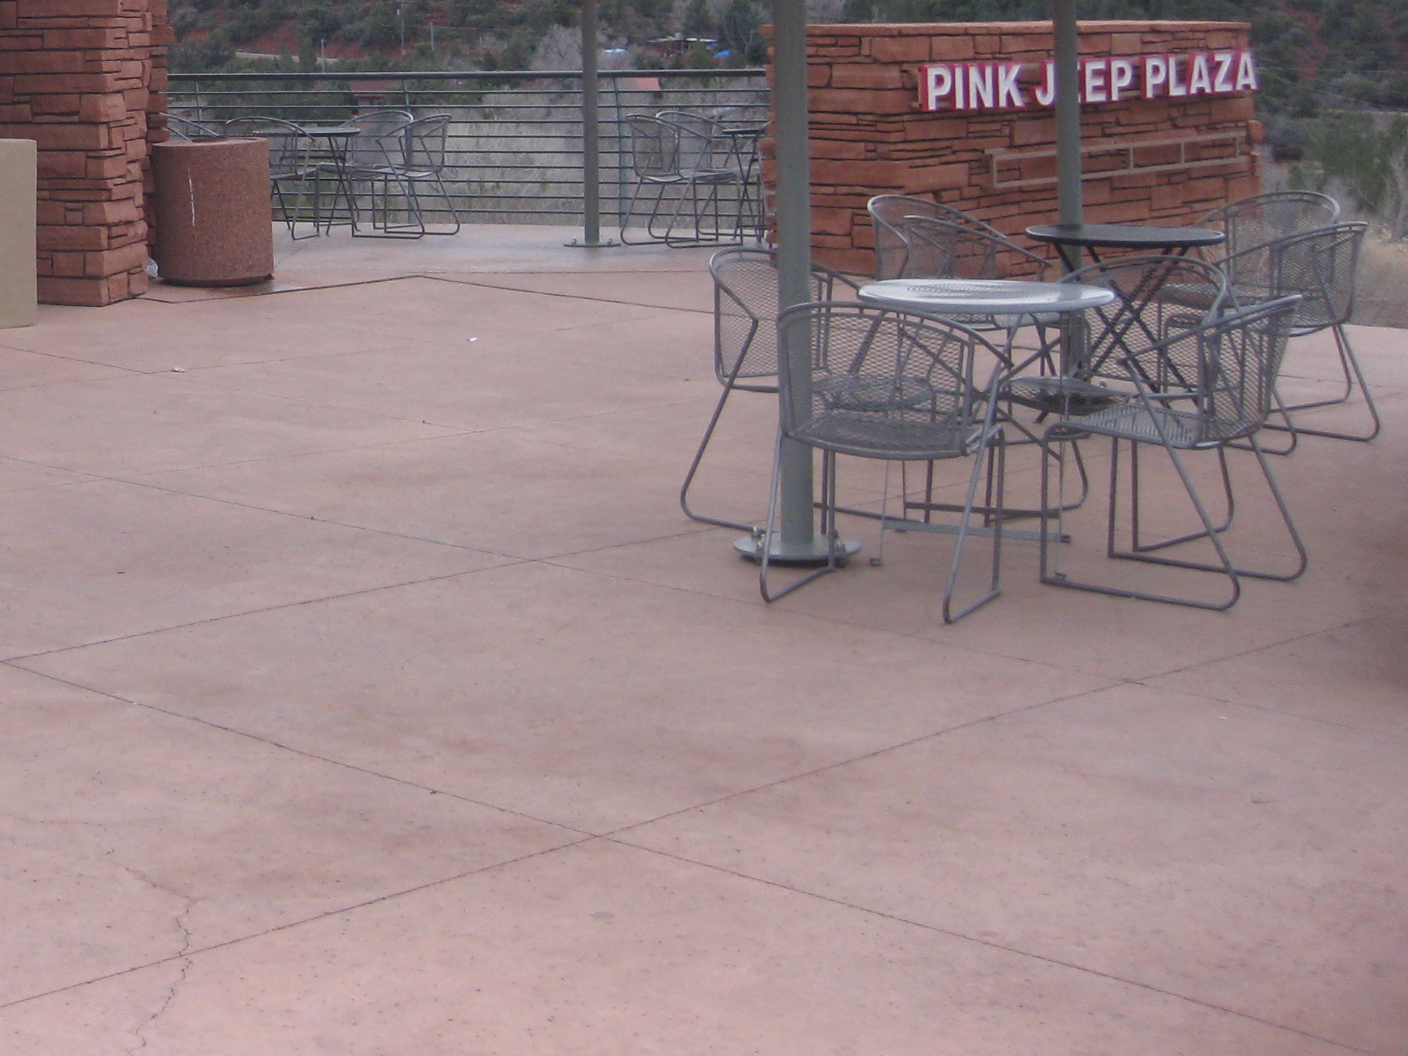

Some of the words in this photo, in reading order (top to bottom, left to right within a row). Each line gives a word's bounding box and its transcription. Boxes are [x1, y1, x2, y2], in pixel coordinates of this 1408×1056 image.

[922, 62, 1026, 111] PINK
[1032, 57, 1133, 106] JEP
[1143, 49, 1258, 98] PLAZA
